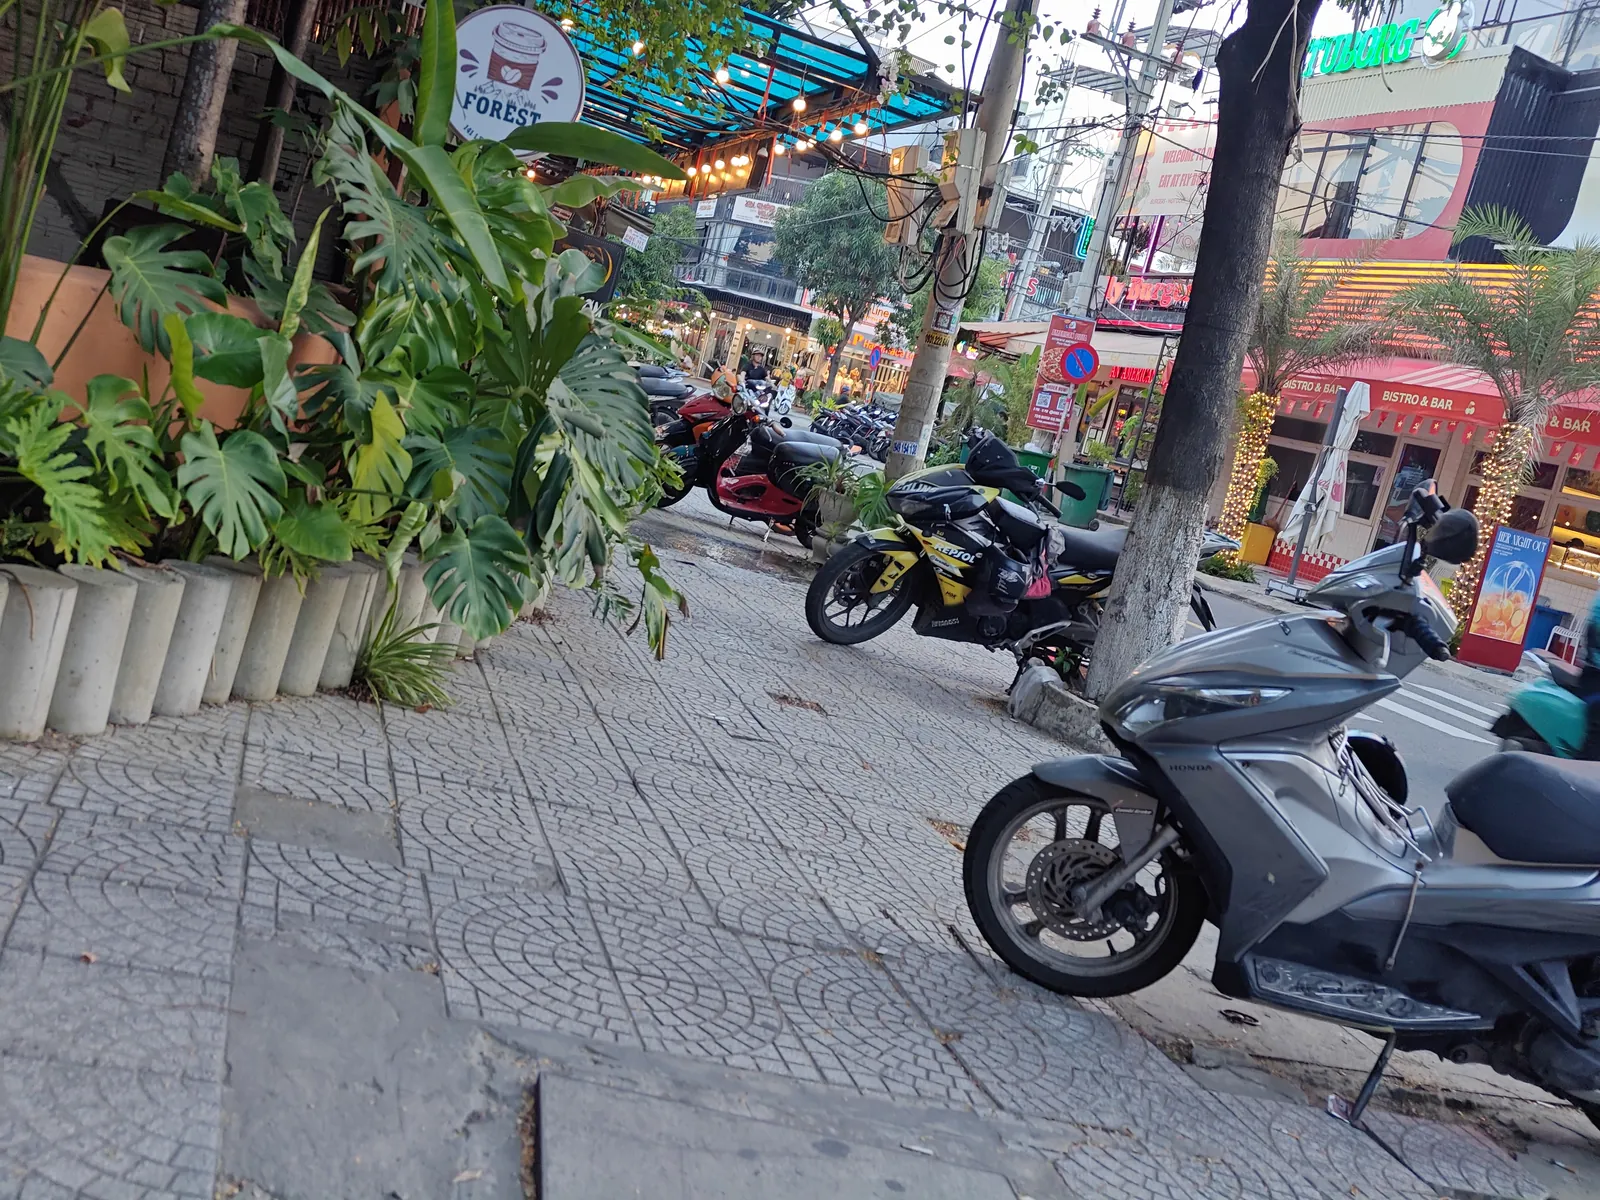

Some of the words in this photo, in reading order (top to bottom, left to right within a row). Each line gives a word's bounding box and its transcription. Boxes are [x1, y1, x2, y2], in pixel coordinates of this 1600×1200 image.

[1302, 17, 1420, 78] TUBORG
[463, 92, 541, 126] FOREST
[1163, 148, 1195, 164] WELCOME
[1158, 174, 1172, 188] EAT
[1170, 174, 1181, 188] AT
[1179, 173, 1192, 187] FLY
[1283, 379, 1313, 392] BISTRO
[1314, 382, 1321, 393] &
[1382, 390, 1419, 405] BISTRO
[1420, 395, 1428, 407] &
[1429, 396, 1453, 411] BAR
[1550, 415, 1559, 428] &
[1562, 417, 1591, 433] BAR
[1498, 531, 1511, 544] HER
[1512, 534, 1533, 550] NIGHT
[1532, 540, 1547, 553] OUT
[934, 542, 975, 564] REPSOL
